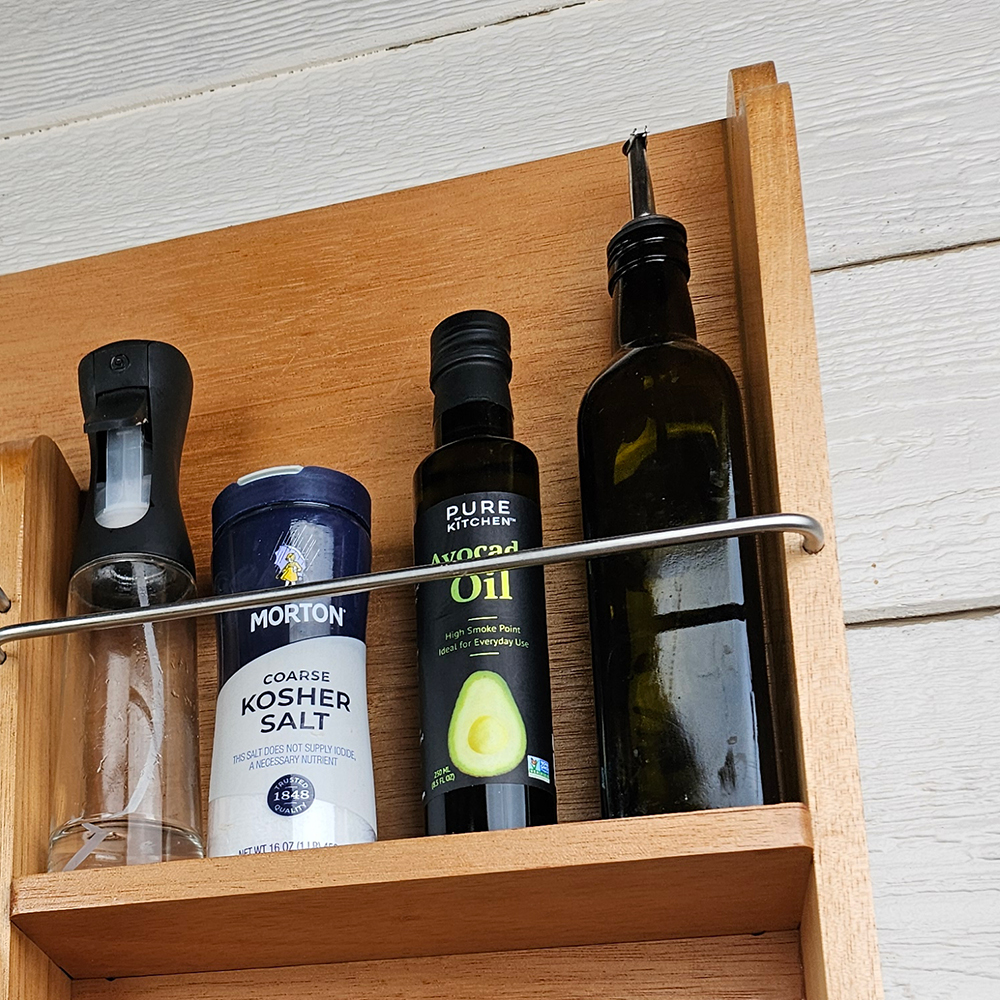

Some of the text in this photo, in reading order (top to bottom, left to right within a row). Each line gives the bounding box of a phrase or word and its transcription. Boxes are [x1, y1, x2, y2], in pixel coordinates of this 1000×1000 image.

[446, 500, 510, 516] PURE
[432, 540, 519, 565] Avocad
[450, 570, 513, 603] Oil
[250, 603, 344, 632] MORTON
[445, 624, 521, 640] High Smoke Point
[438, 637, 530, 656] Ideal for Everyday Use
[263, 670, 330, 685] COARSE
[241, 687, 351, 717] KOSHER
[260, 711, 330, 734] SALT
[233, 753, 246, 765] THIS
[246, 747, 263, 760] SALT
[264, 744, 285, 756] DOES
[286, 743, 302, 753] NOT
[304, 743, 333, 754] SUPPLY
[248, 755, 338, 771] A NECESSARY NUTRIENT
[274, 776, 309, 790] TRUSTED
[273, 789, 310, 802] 1848
[274, 801, 307, 814] QUALITY
[269, 842, 280, 853] 16
